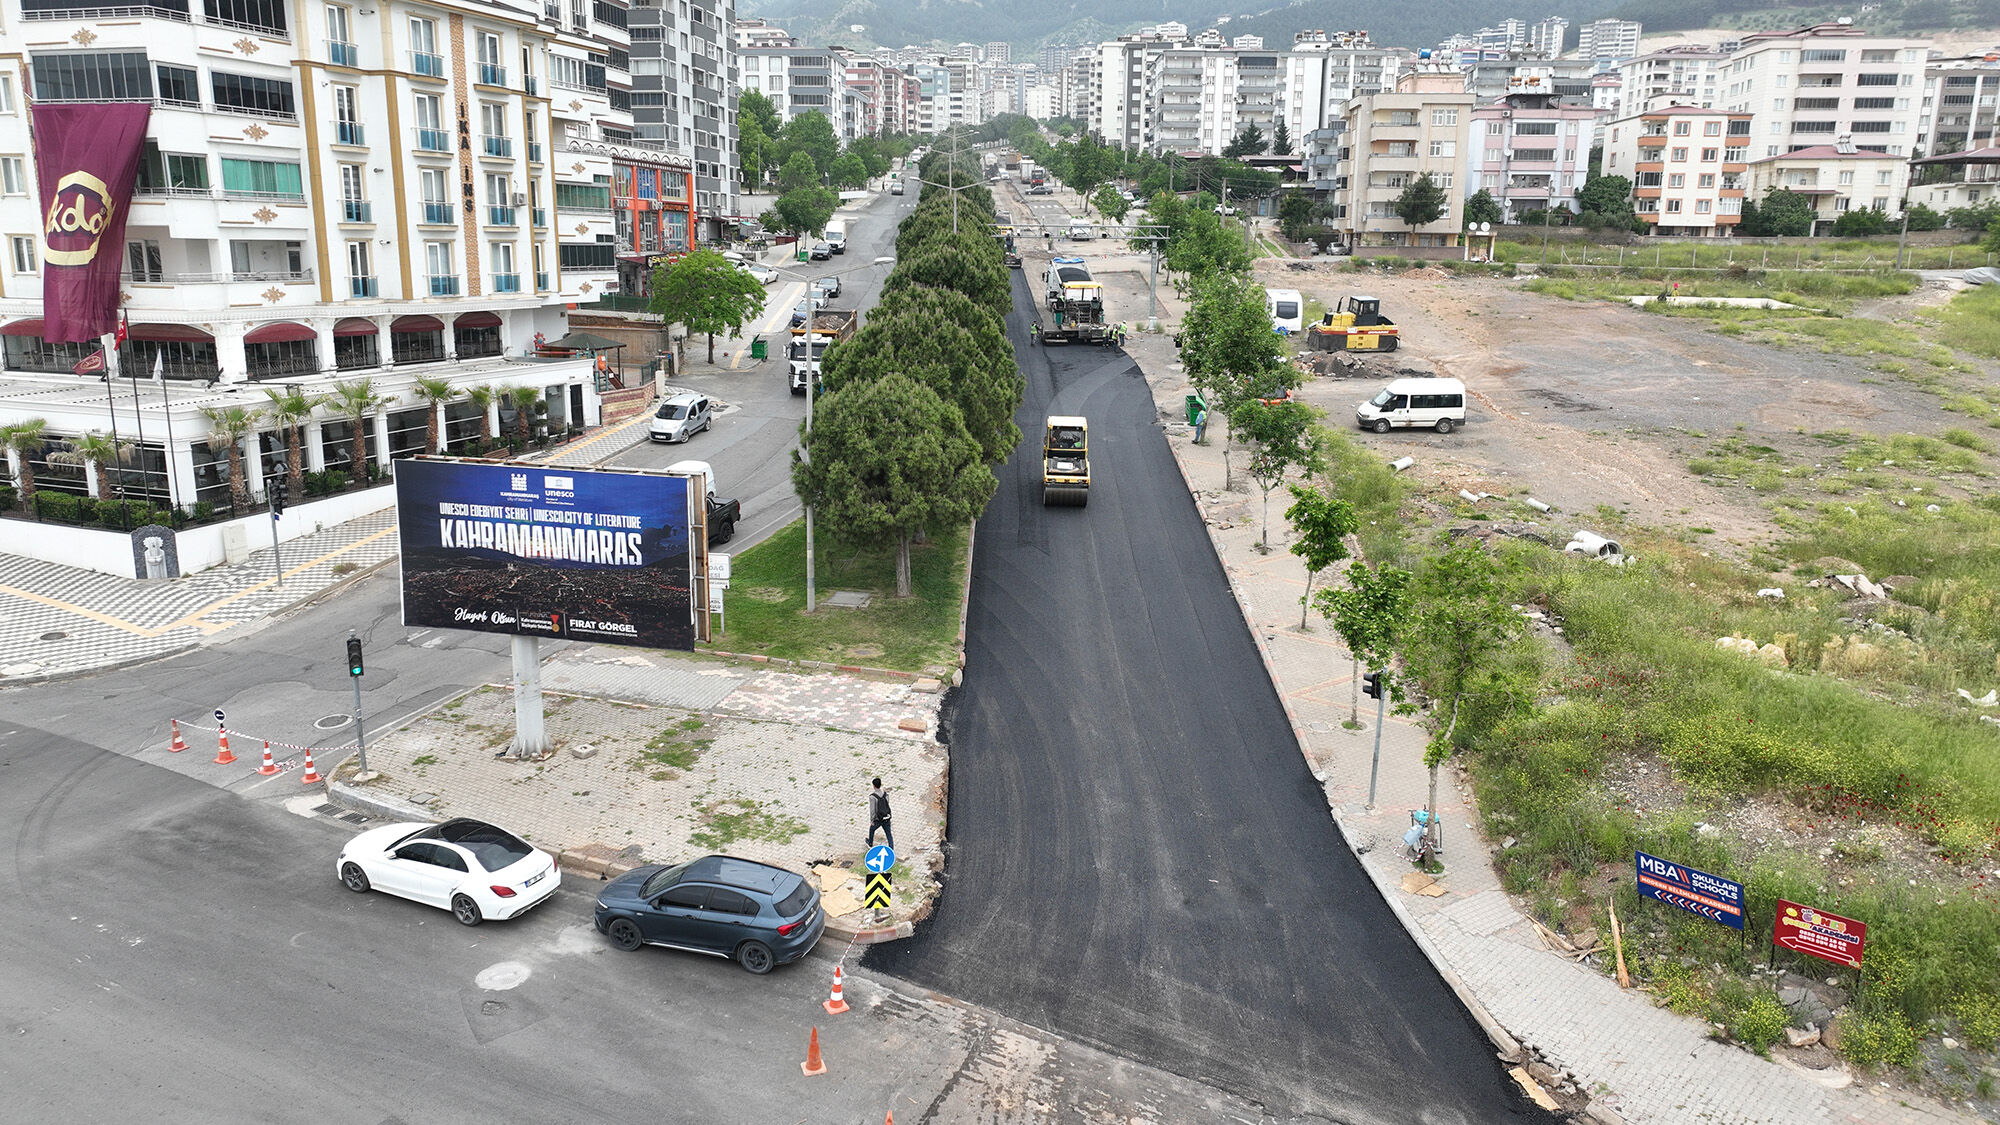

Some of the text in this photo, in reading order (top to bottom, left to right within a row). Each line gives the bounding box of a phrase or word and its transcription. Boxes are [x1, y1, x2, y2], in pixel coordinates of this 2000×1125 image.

[545, 490, 575, 498] unesco
[440, 502, 469, 517] UNESCO
[533, 508, 564, 523] UNESCO
[564, 511, 582, 525] CITY
[584, 512, 593, 526] OF
[595, 513, 642, 529] LITERATURE
[569, 619, 597, 629] FIRAT
[598, 621, 638, 633] GÖRGEL
[1640, 855, 1680, 881] MBA
[1691, 873, 1738, 893] OKULLARI
[1691, 880, 1738, 900] SCHOOLS
[1641, 876, 1668, 890] MODERN
[1700, 897, 1738, 914] AKADEMİSİ
